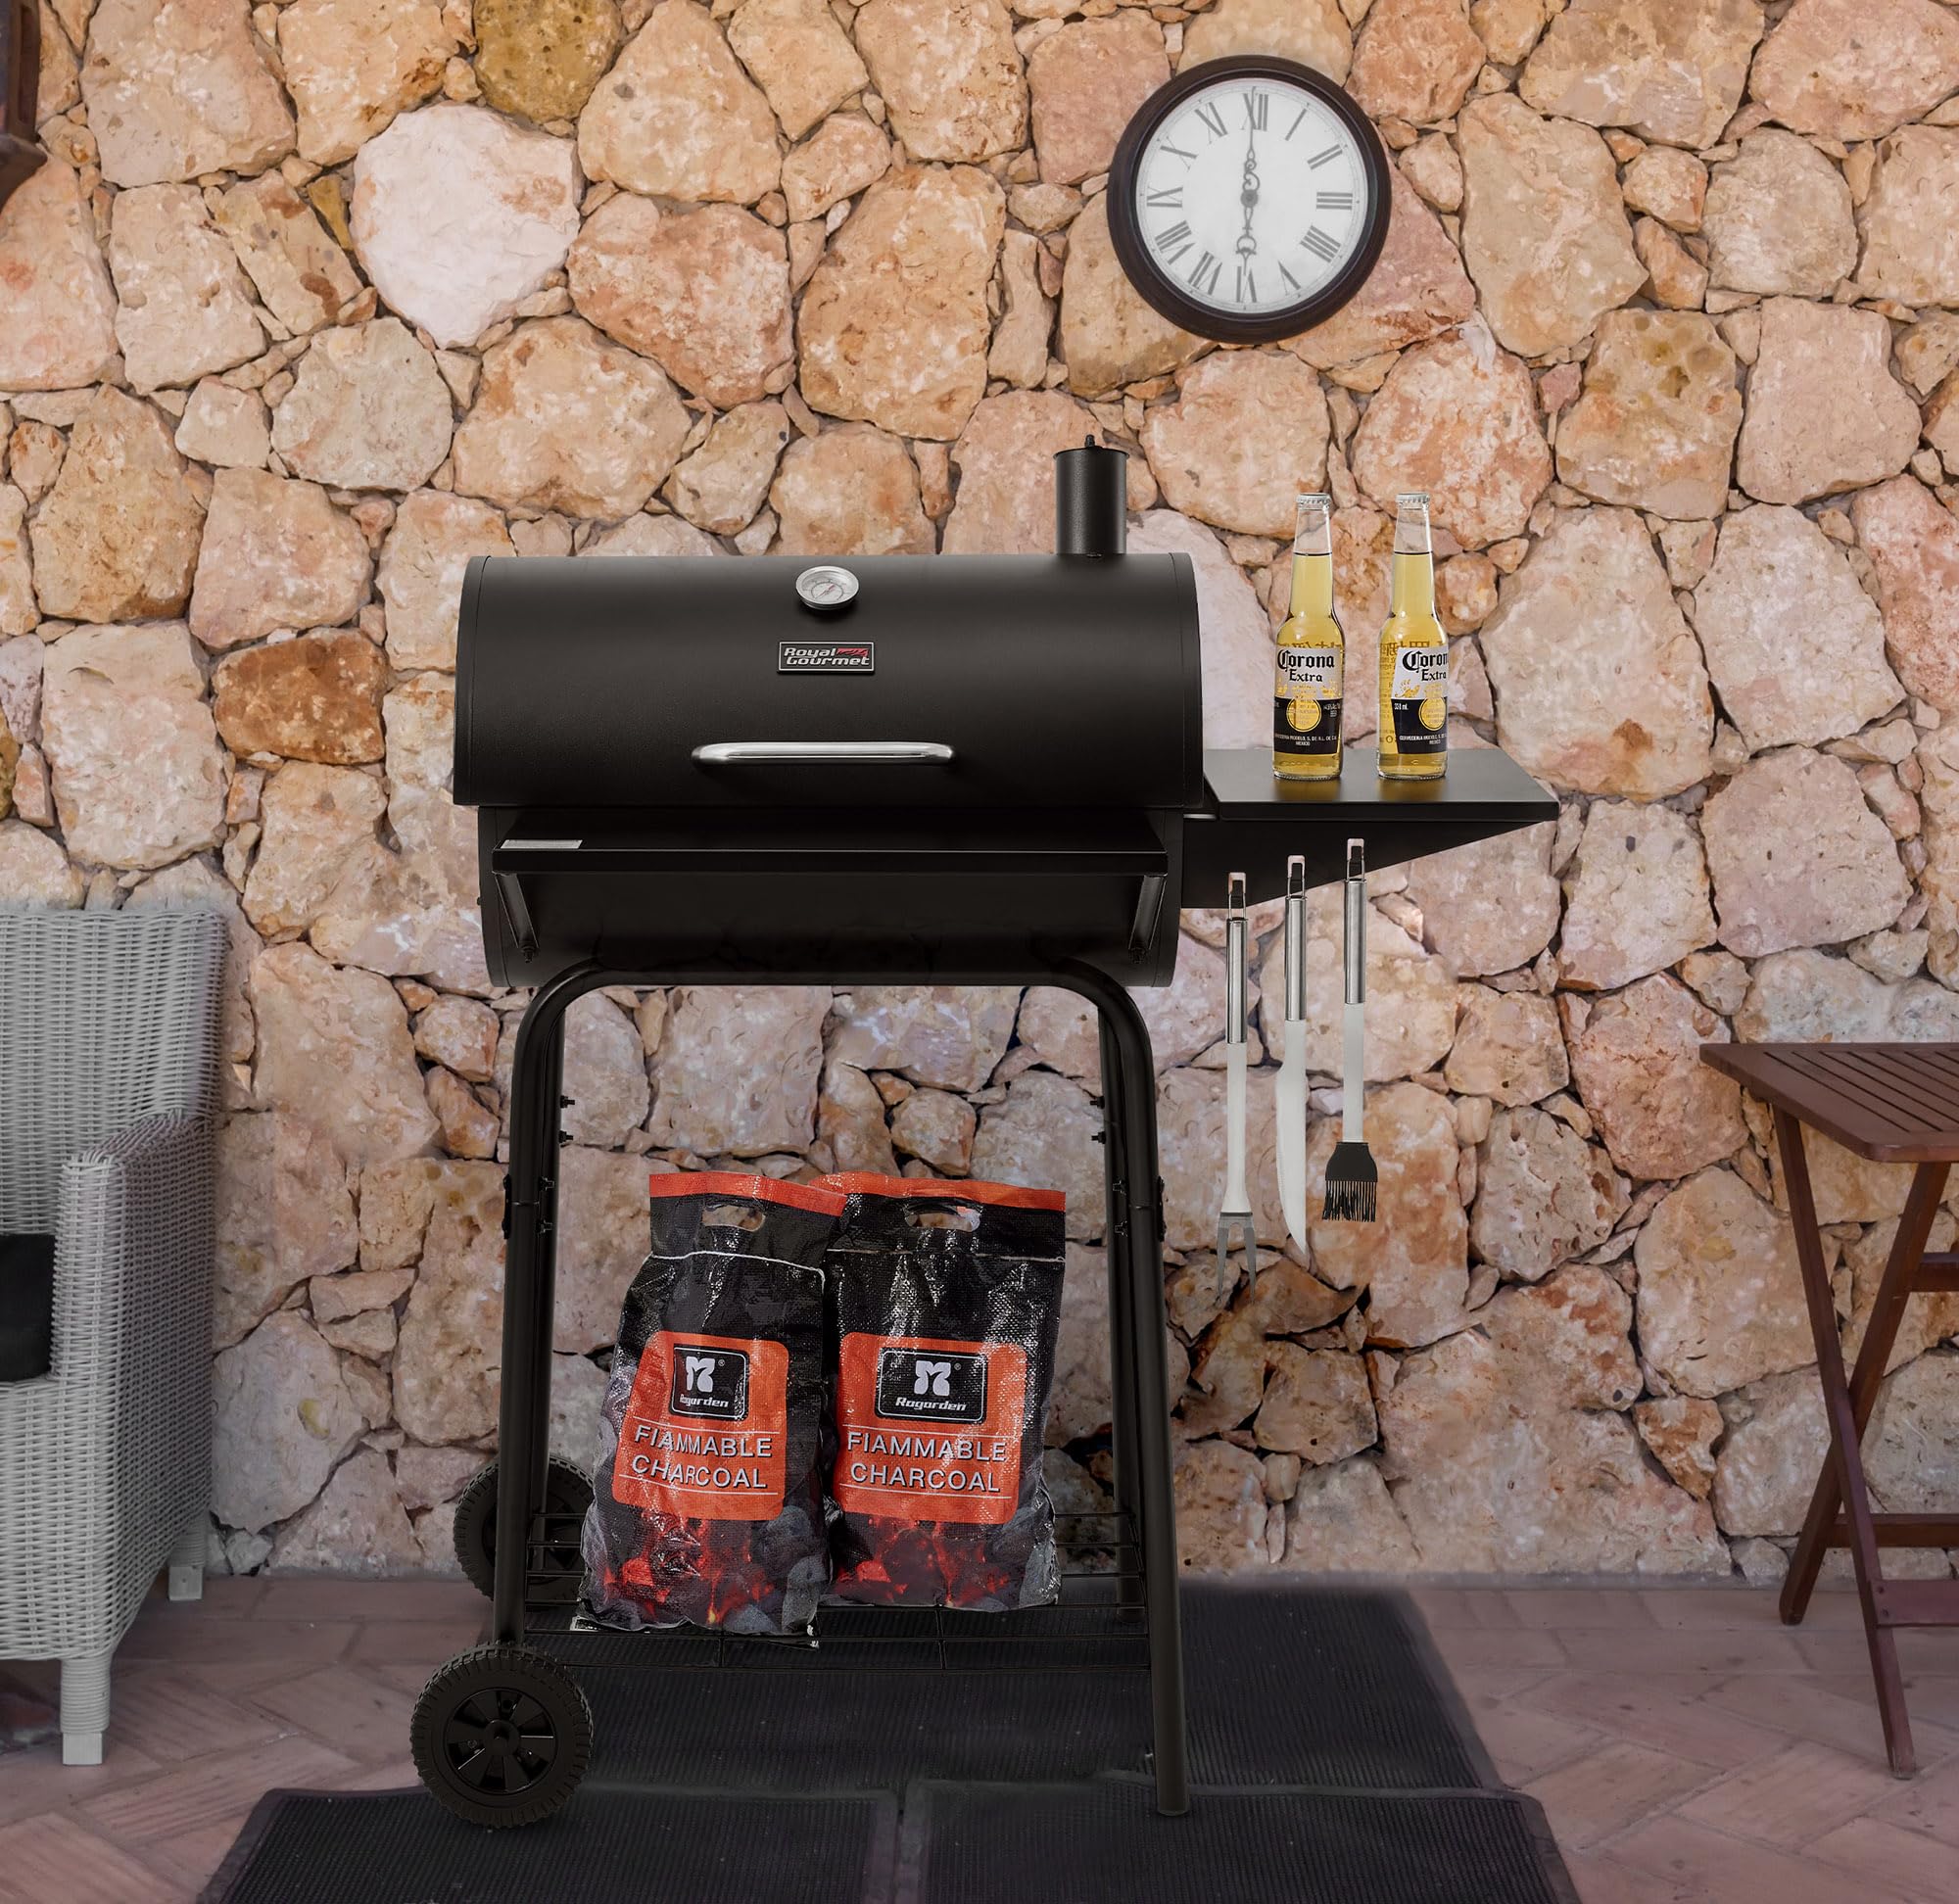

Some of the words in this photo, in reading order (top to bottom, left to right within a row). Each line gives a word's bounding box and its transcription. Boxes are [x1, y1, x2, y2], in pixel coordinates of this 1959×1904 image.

[1240, 93, 1268, 131] XII
[1315, 192, 1353, 210] III
[785, 647, 836, 657] Royal
[787, 656, 870, 665] Gourmet
[1277, 649, 1335, 672] Corona
[1403, 650, 1448, 673] Coron
[1289, 669, 1323, 682] Extra
[1421, 669, 1447, 682] Extra
[895, 1397, 968, 1411] Rogarden
[631, 1454, 767, 1489] CHARCOAL
[850, 1462, 1001, 1493] CHARCOAL
